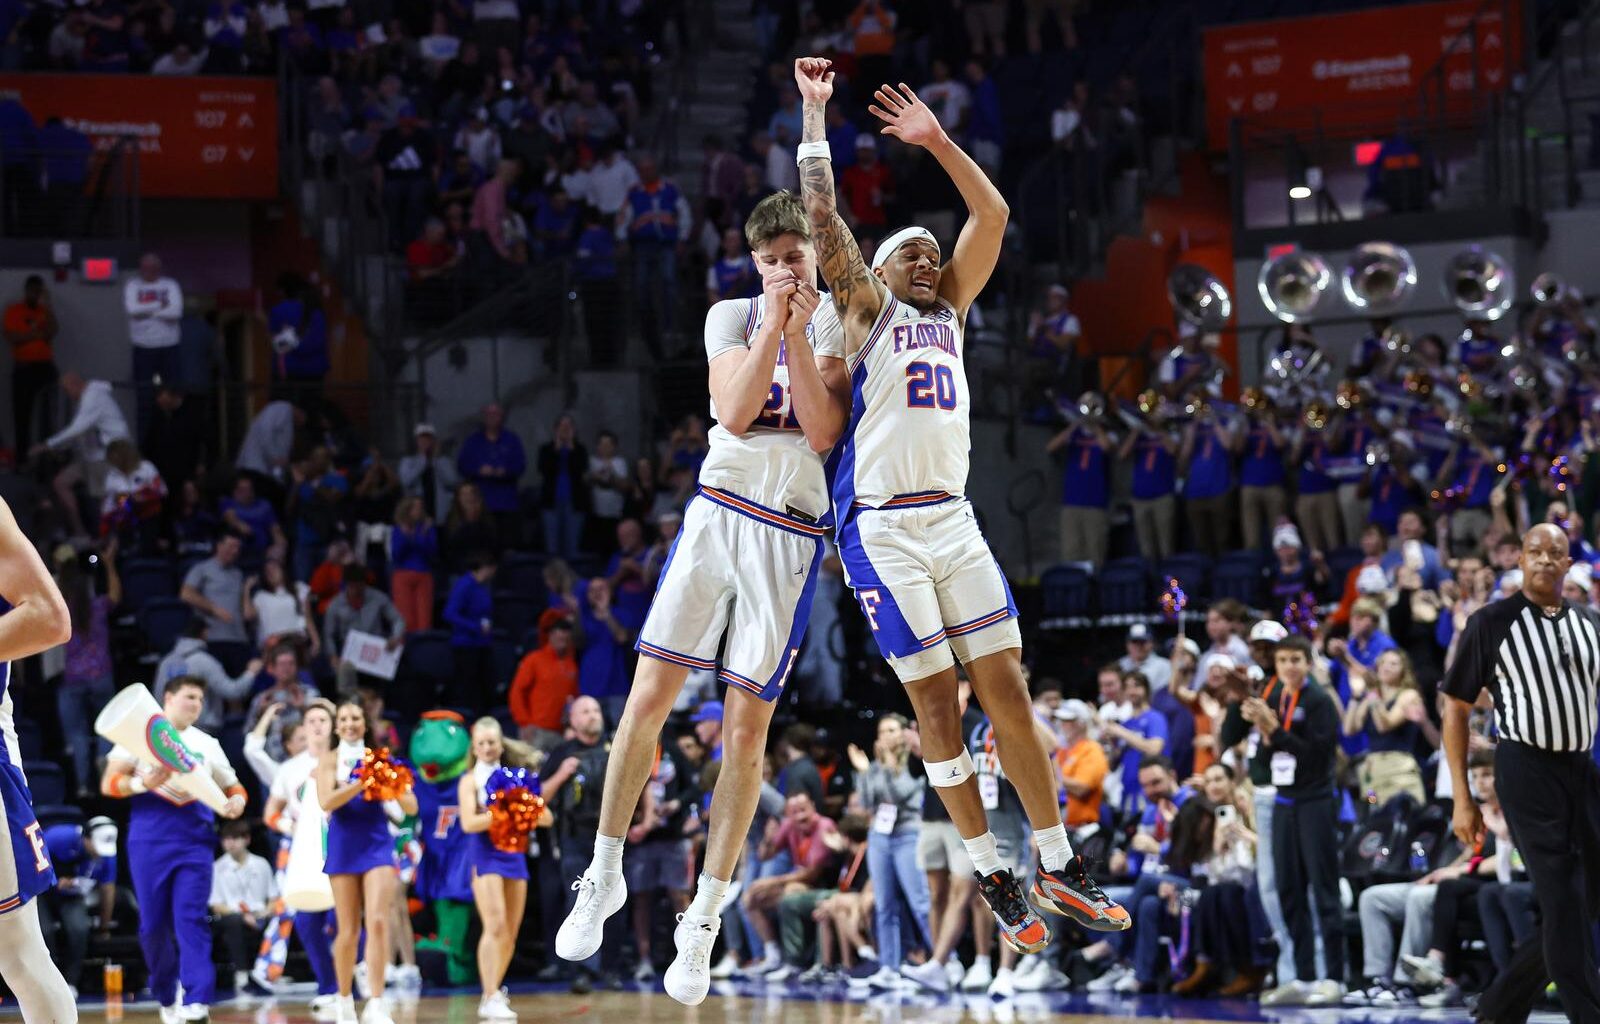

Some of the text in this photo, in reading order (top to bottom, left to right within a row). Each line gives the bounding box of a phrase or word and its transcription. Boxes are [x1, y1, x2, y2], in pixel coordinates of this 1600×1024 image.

[892, 322, 959, 359] FLORIDA
[905, 361, 957, 411] 20
[858, 589, 882, 631] F
[433, 805, 460, 840] F
[24, 820, 50, 873] F
